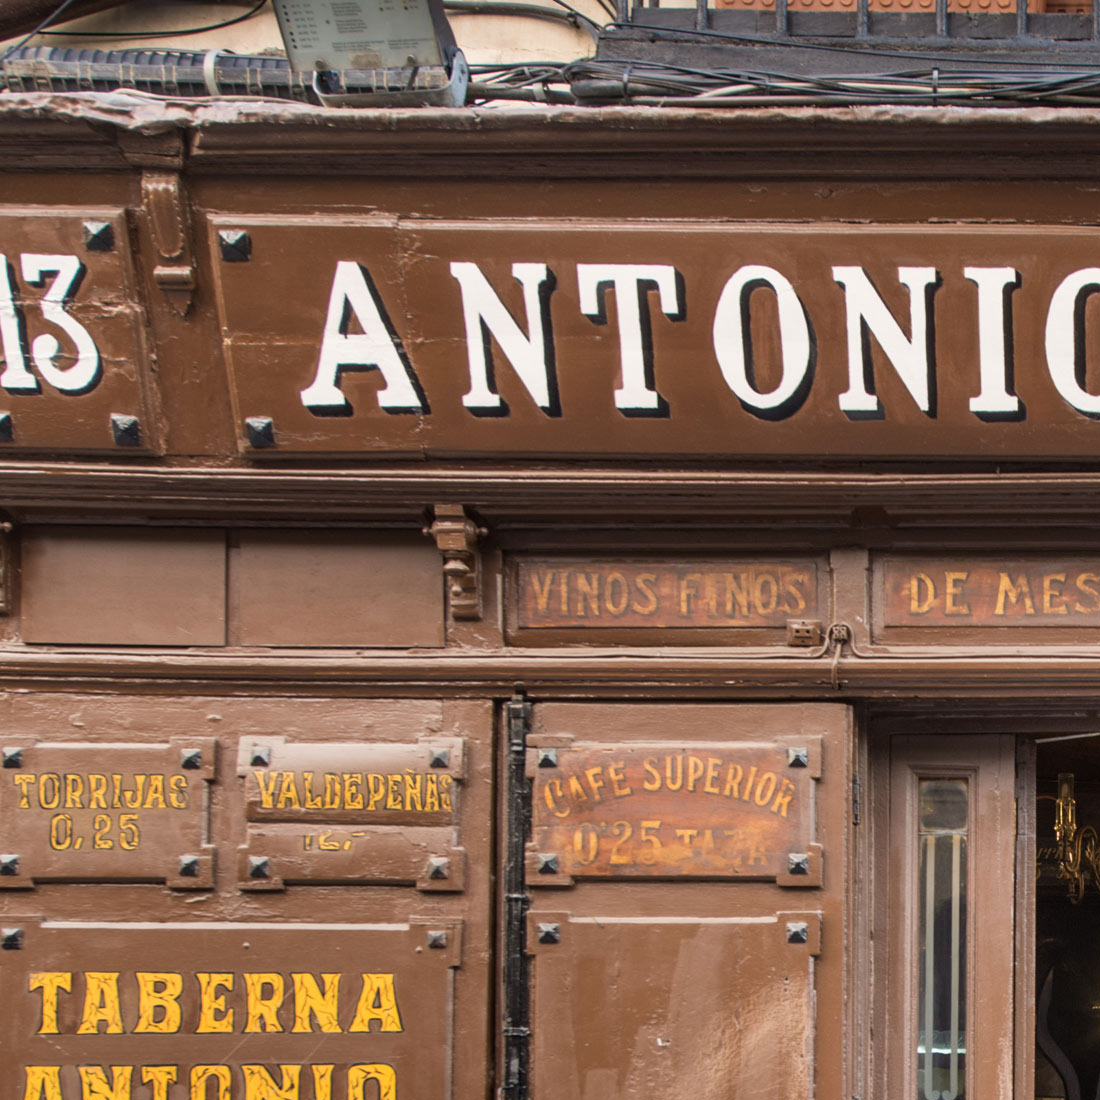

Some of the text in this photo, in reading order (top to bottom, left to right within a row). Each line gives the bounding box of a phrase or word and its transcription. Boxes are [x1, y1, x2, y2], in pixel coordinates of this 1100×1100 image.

[0, 253, 102, 395] 13
[530, 570, 808, 617] VINOS FINOS
[909, 571, 971, 616] DE
[13, 773, 189, 810] TORRIJAS
[254, 768, 453, 812] VALDEPEÑAS
[544, 755, 797, 818] CAFE SUPERIOR
[29, 971, 404, 1035] TABERNA
